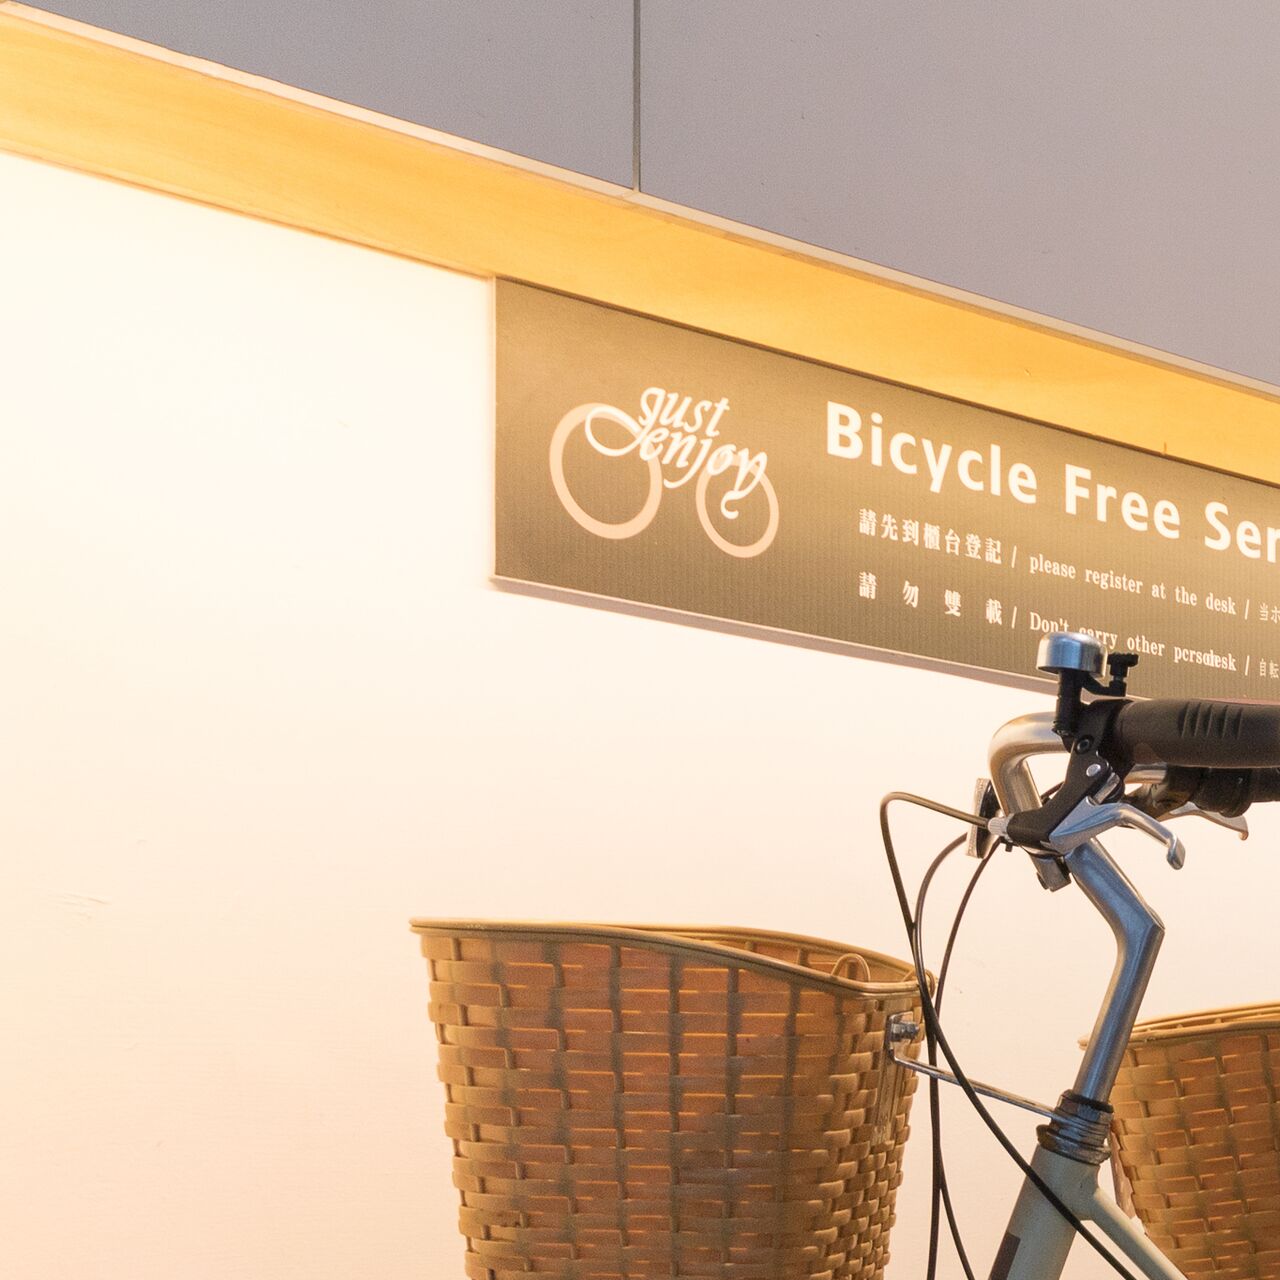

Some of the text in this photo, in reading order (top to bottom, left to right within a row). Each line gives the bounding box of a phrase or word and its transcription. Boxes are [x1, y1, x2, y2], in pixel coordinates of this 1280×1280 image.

[639, 426, 767, 519] enjoy
[827, 401, 1037, 504] Bicycle
[1065, 464, 1180, 539] Free
[859, 509, 1001, 564] 請先到櫃台登記
[1030, 554, 1075, 576] please
[1085, 569, 1143, 593] register
[1152, 583, 1166, 599] at
[1175, 586, 1197, 606] the
[1206, 593, 1236, 614] desk
[1030, 612, 1070, 632] Don't
[1127, 635, 1165, 656] other
